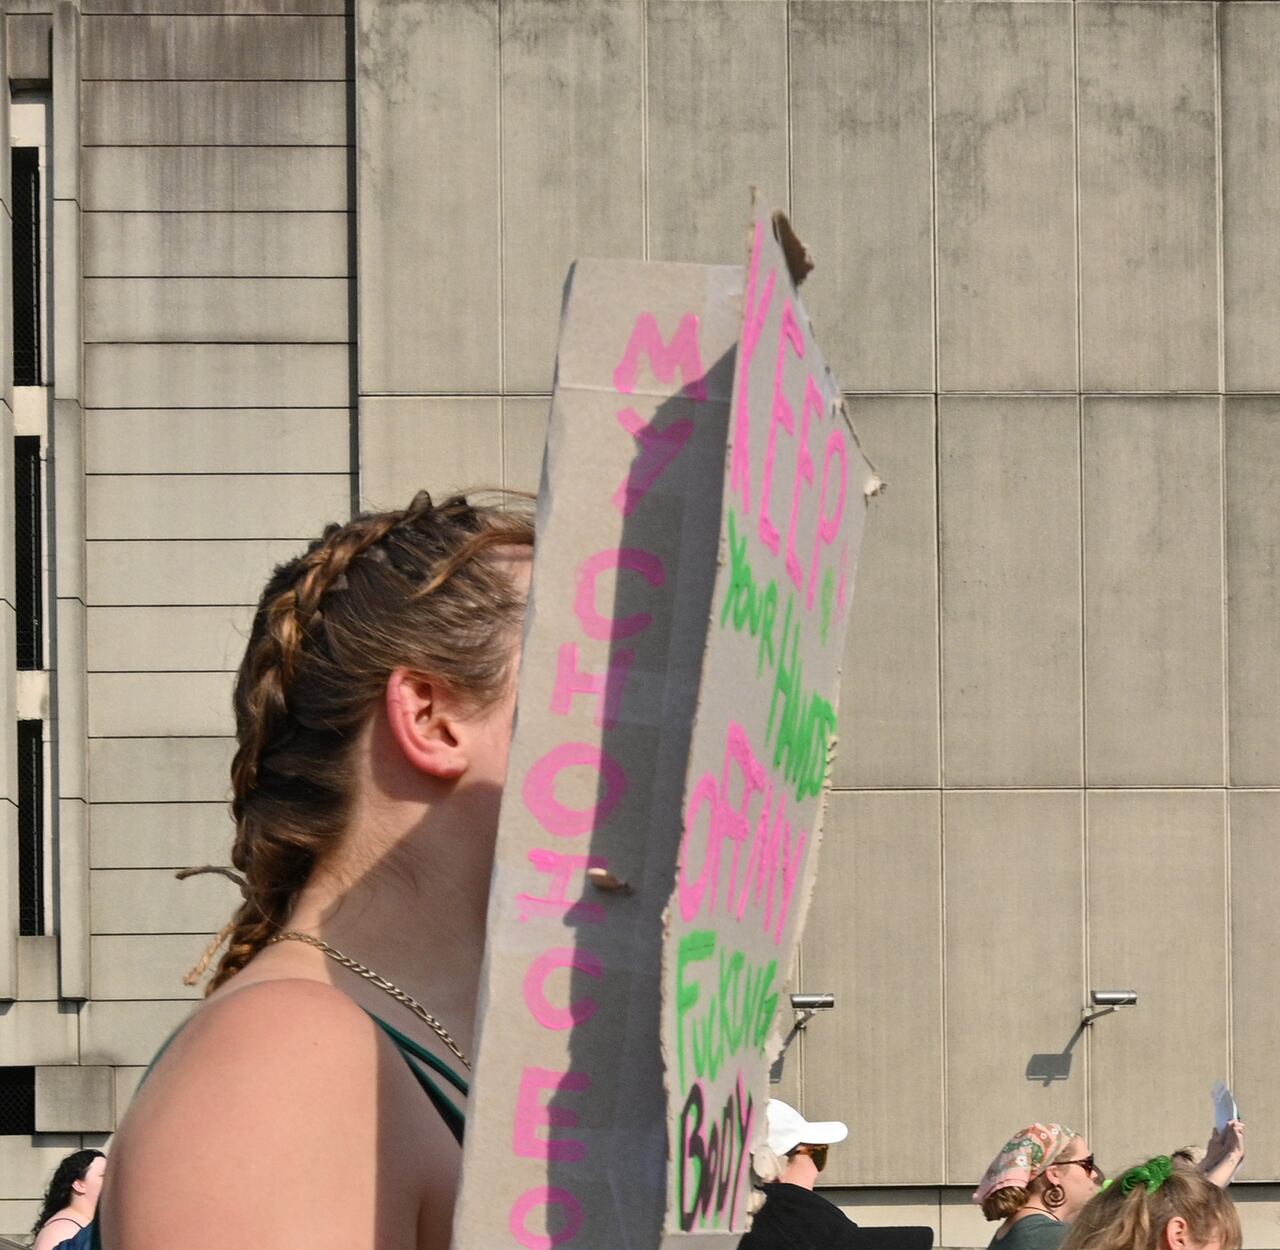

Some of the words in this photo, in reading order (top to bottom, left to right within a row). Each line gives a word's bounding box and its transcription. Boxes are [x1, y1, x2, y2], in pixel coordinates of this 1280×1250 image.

[612, 311, 708, 518] MY
[730, 222, 848, 612] KEEP
[720, 506, 777, 680] YOUR
[678, 720, 769, 923] OFF
[735, 777, 807, 946] MY
[676, 929, 779, 1097] FUCKING
[679, 1068, 754, 1235] BODY
